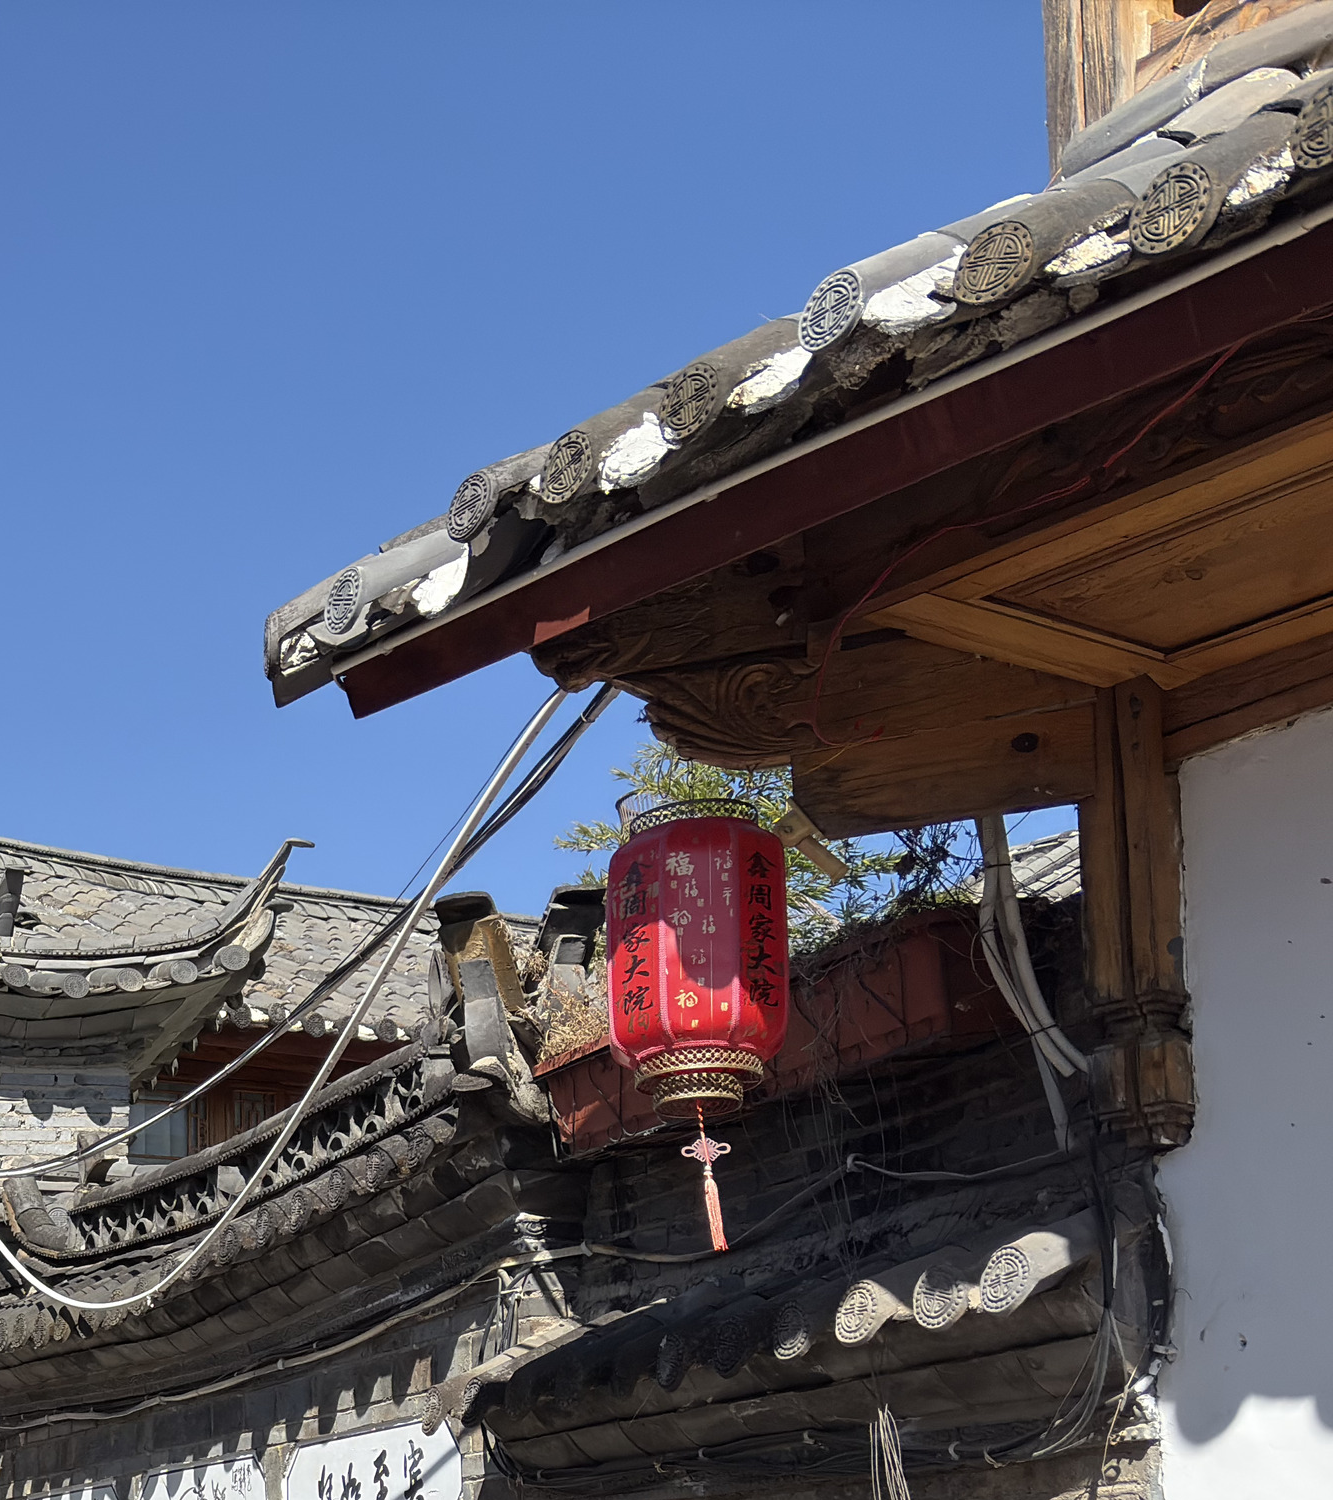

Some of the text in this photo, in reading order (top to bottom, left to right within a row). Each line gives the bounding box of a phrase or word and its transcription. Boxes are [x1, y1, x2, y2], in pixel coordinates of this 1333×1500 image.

[666, 852, 695, 877] 福
[746, 851, 779, 1008] 鑫周家大院
